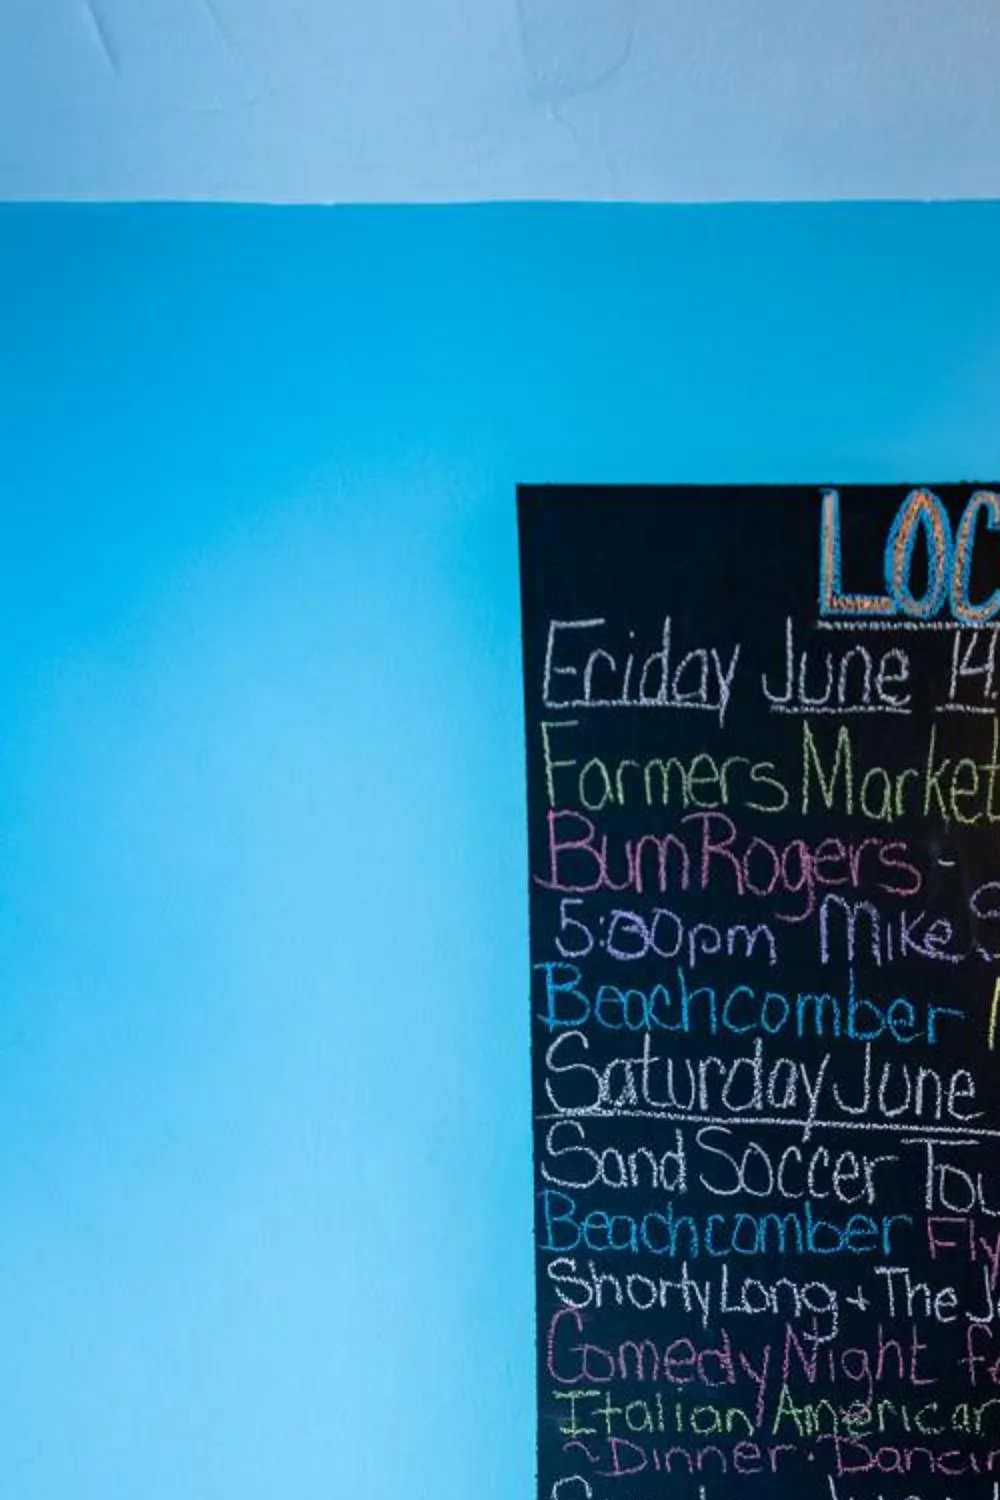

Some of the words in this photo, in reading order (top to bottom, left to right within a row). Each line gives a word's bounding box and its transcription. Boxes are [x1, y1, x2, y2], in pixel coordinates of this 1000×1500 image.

[542, 616, 740, 727] Friday
[762, 616, 910, 705] June
[949, 628, 999, 699] 14
[541, 720, 789, 811] Farmers
[681, 810, 922, 921] Rogers
[819, 892, 965, 967] Mike
[534, 961, 965, 1045] Beachcomber
[544, 1030, 831, 1143] Saturday
[832, 1041, 986, 1121] June
[540, 1119, 688, 1193] Sand
[696, 1126, 901, 1205] Soccer
[537, 1189, 913, 1256] Beachcomber
[546, 1256, 712, 1329] Shorty
[720, 1263, 839, 1343] Long
[873, 1265, 958, 1322] The
[546, 1305, 772, 1428] Comedy
[781, 1316, 939, 1416] Night
[551, 1388, 758, 1438] Italian
